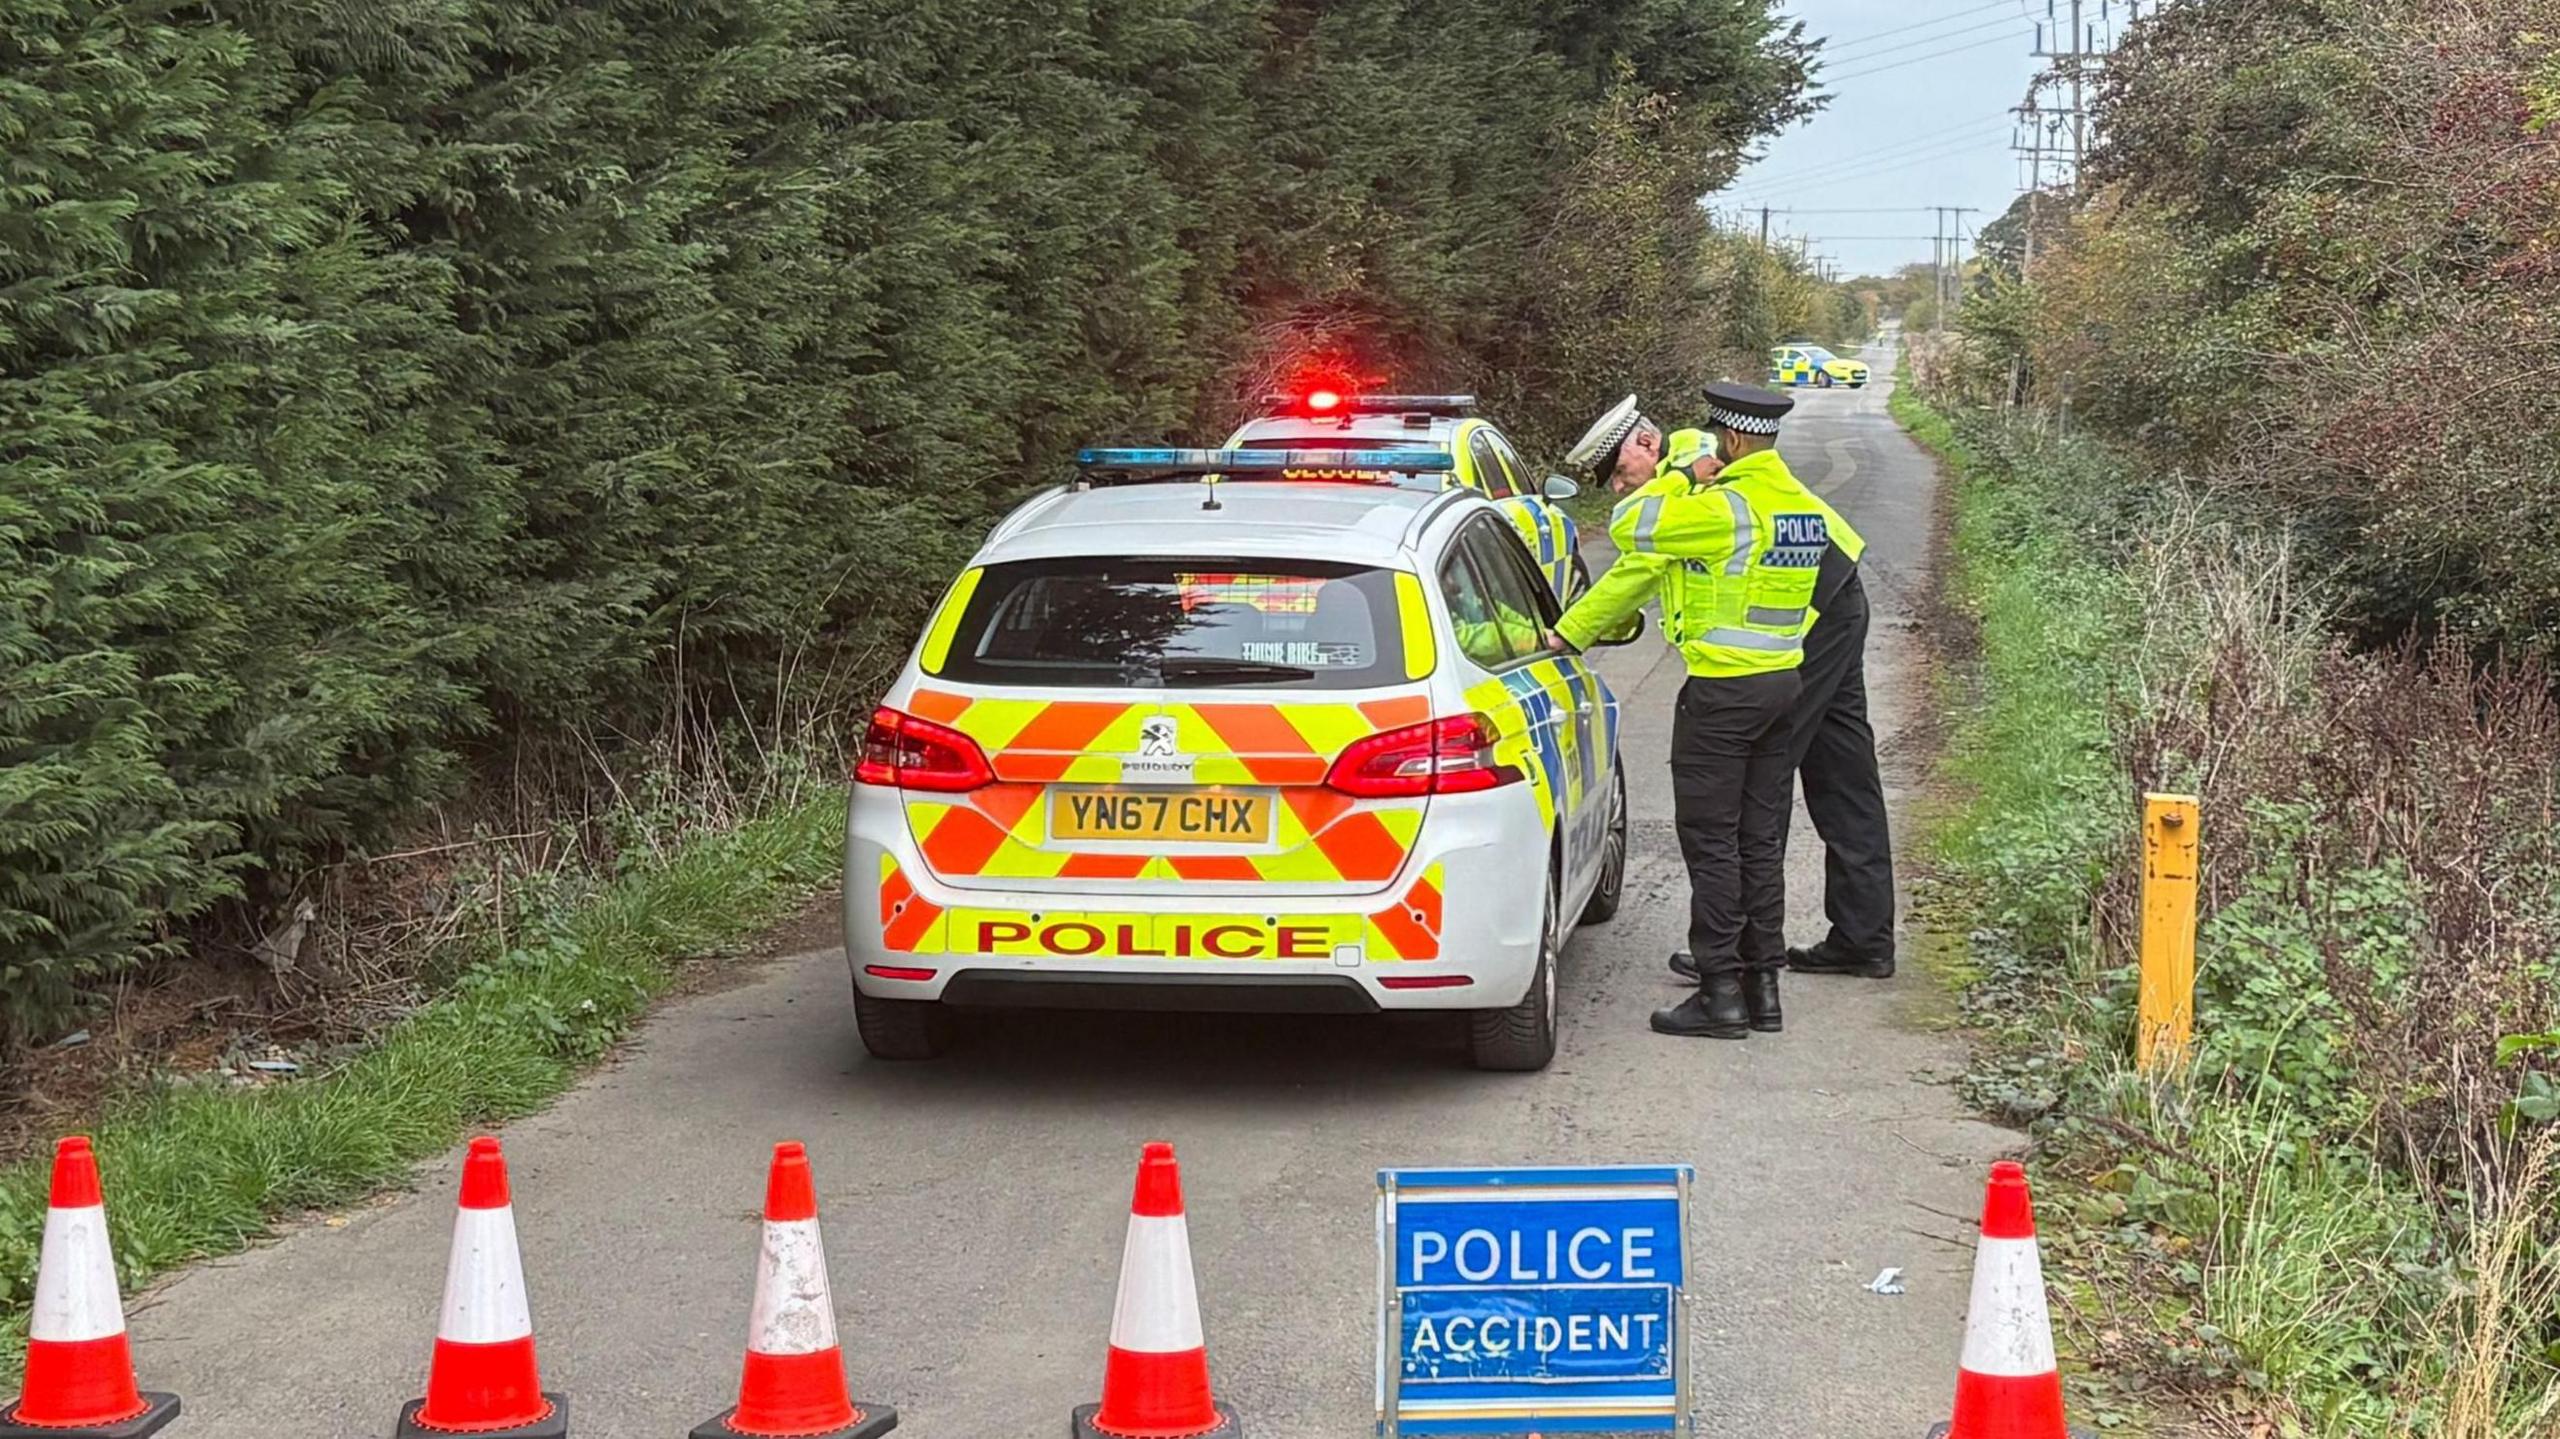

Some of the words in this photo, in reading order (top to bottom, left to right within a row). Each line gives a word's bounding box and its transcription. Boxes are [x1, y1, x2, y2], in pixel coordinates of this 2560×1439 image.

[1777, 517, 1826, 543] POLICE
[1071, 795, 1169, 832] YN67
[1179, 797, 1255, 834] CHX
[977, 921, 1331, 959] POLICE
[1412, 1226, 1656, 1282] POLICE
[1410, 1313, 1660, 1353] ACCIDENT
